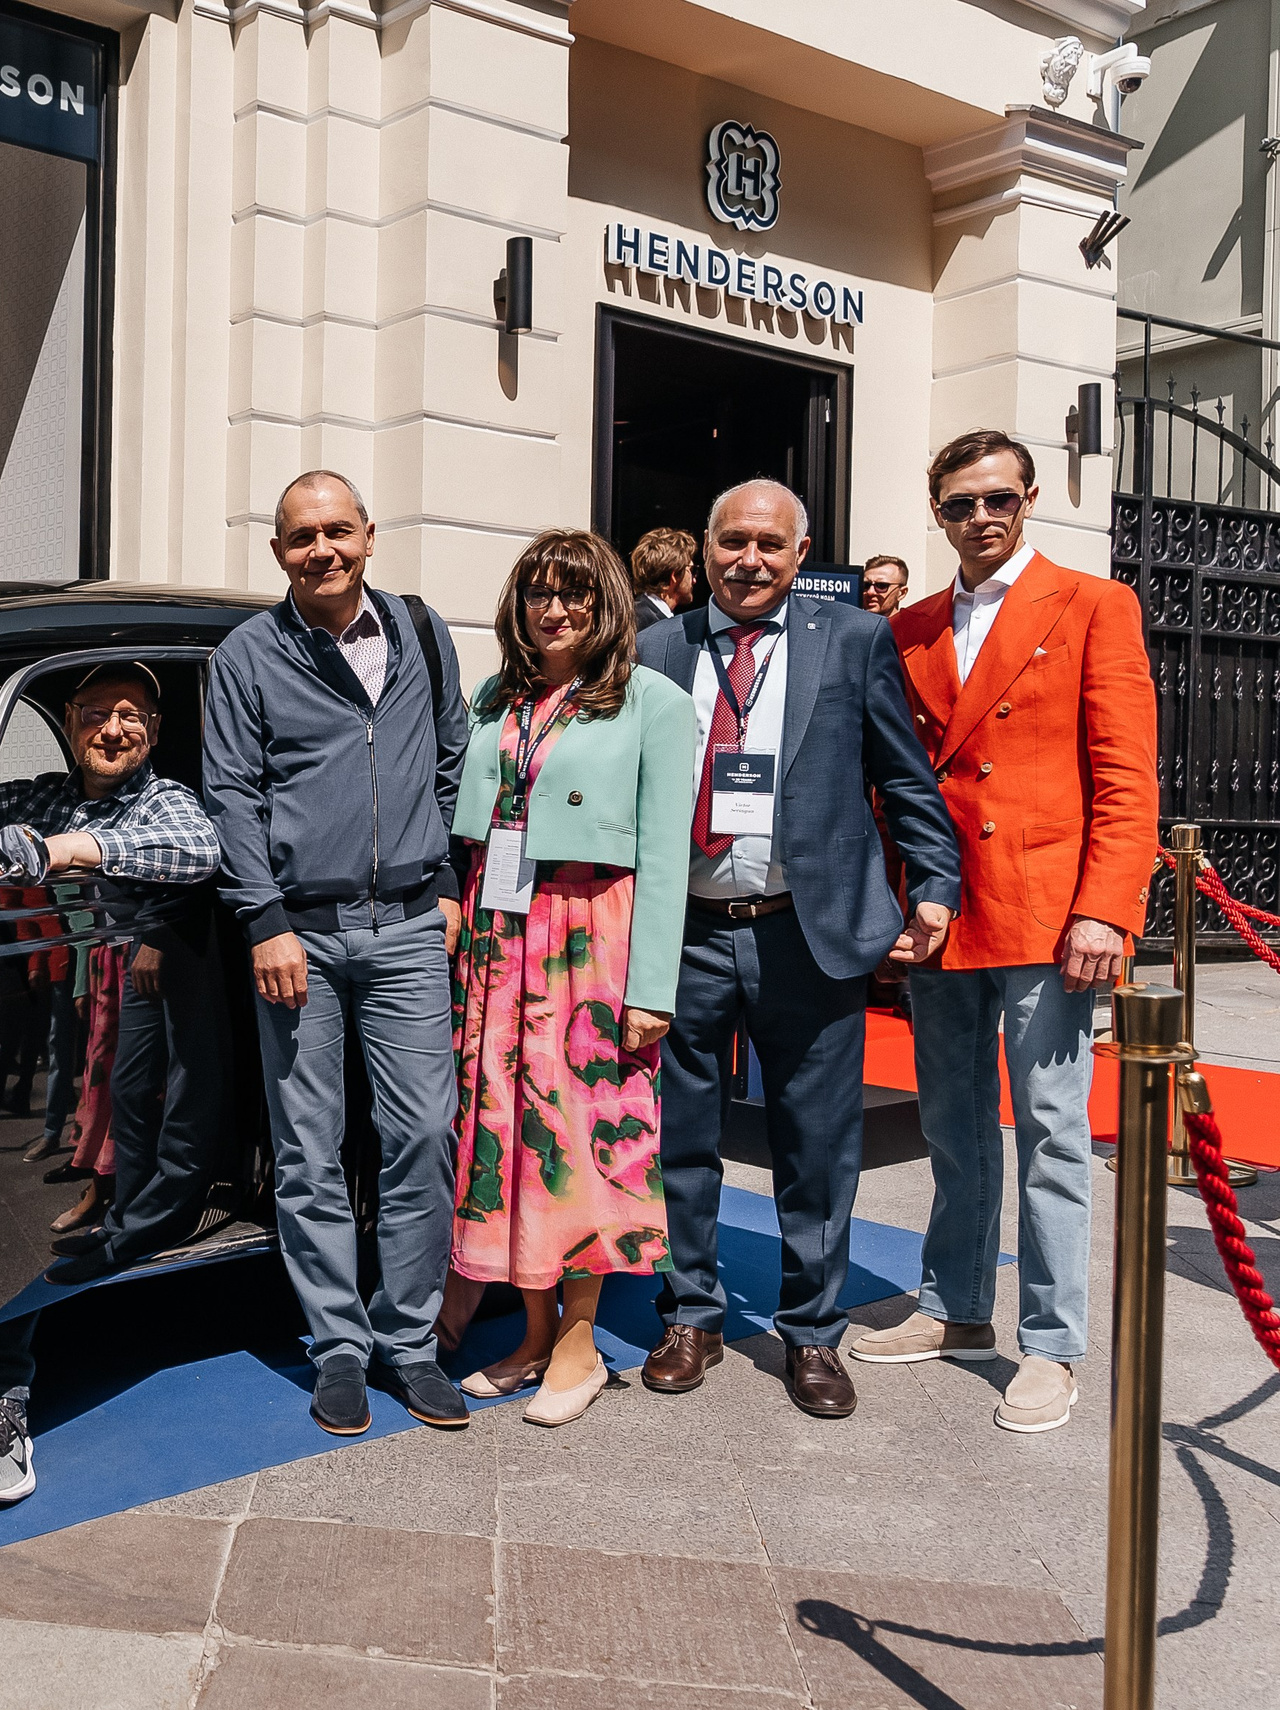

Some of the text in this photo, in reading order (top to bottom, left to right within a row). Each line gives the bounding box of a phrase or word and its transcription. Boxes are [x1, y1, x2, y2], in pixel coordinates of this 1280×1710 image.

[727, 152, 762, 200] H
[610, 222, 864, 327] HENDERSON
[791, 577, 851, 593] ENDERSON
